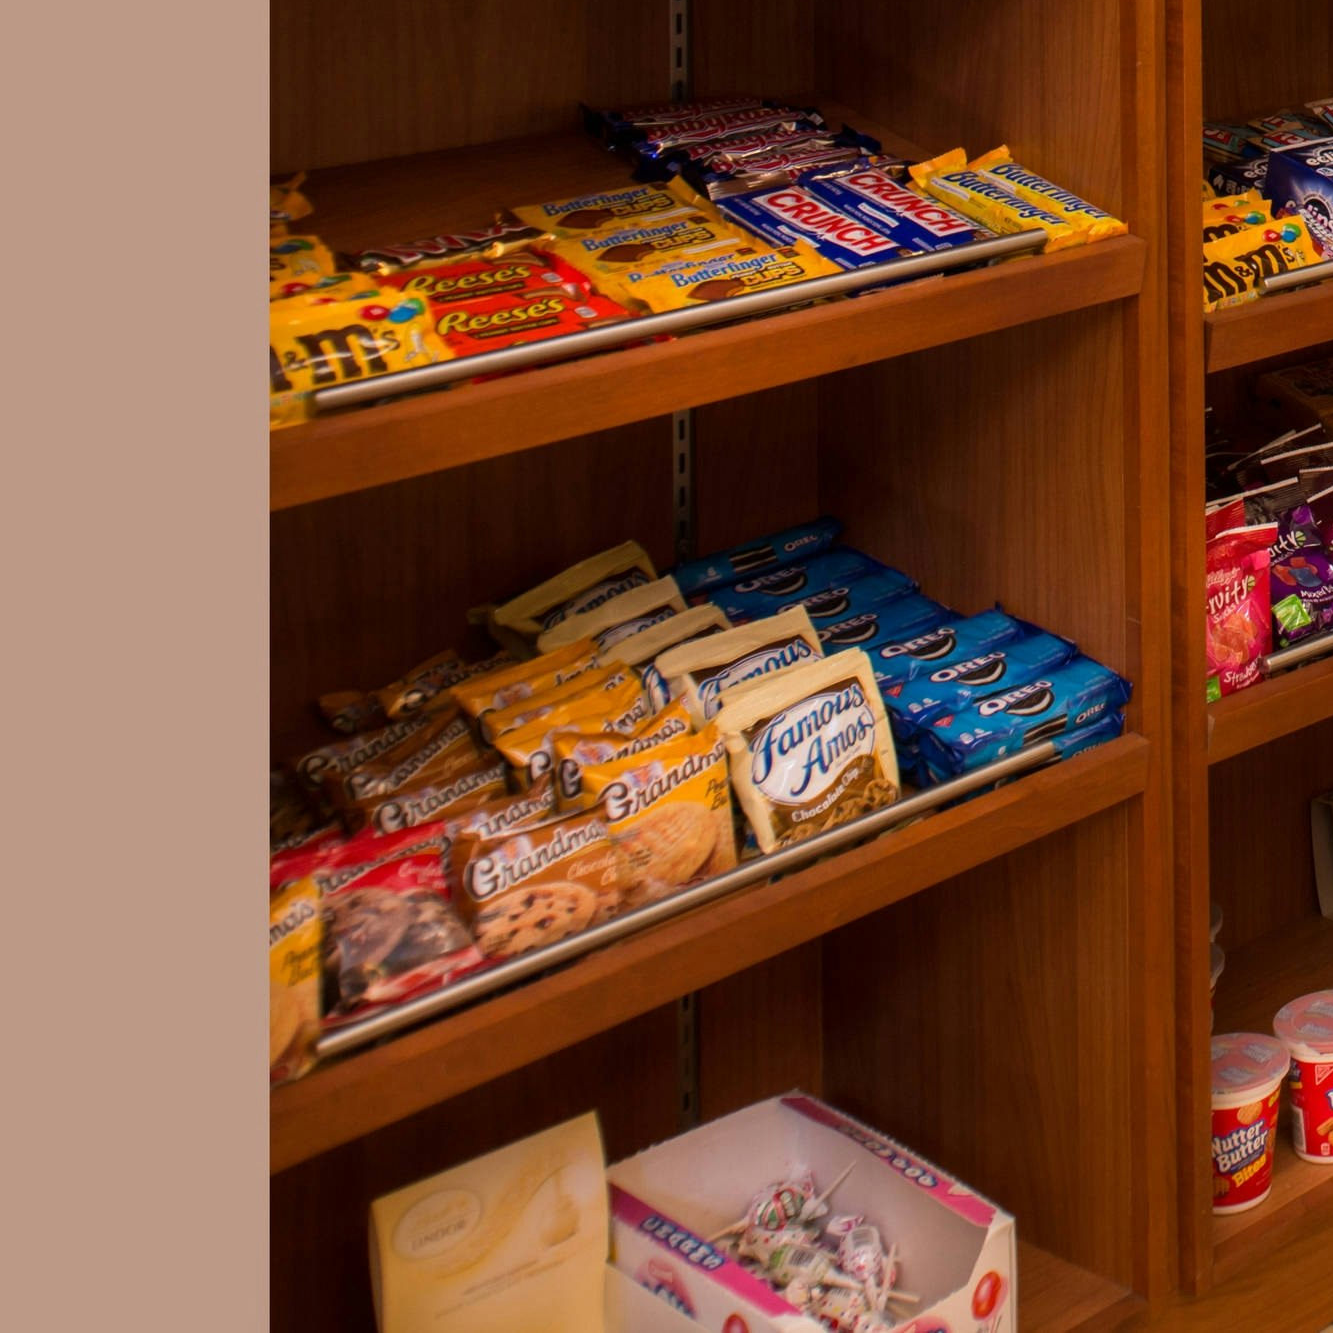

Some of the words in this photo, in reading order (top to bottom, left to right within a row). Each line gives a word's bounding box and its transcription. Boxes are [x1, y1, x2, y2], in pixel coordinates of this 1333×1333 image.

[543, 187, 650, 217] Butterfinger
[850, 171, 968, 234] CRUNCH
[947, 169, 1064, 227] Butterfinger
[583, 220, 689, 252] Butterfinger
[766, 191, 893, 254] CRUNCH
[404, 264, 532, 297] Reese's
[671, 253, 778, 288] Butterfinger
[743, 261, 803, 286] CUPS
[437, 297, 566, 336] Reese's
[880, 627, 954, 658] OREO
[930, 651, 1006, 684] OREO
[979, 678, 1053, 716] OREO
[751, 684, 867, 785] Famous
[792, 713, 874, 795] Amos
[792, 782, 842, 823] Chocolate
[840, 766, 863, 794] Chip
[1211, 1120, 1264, 1155] Nutter
[1216, 1132, 1268, 1173] Butter
[1231, 1154, 1267, 1188] Bites
